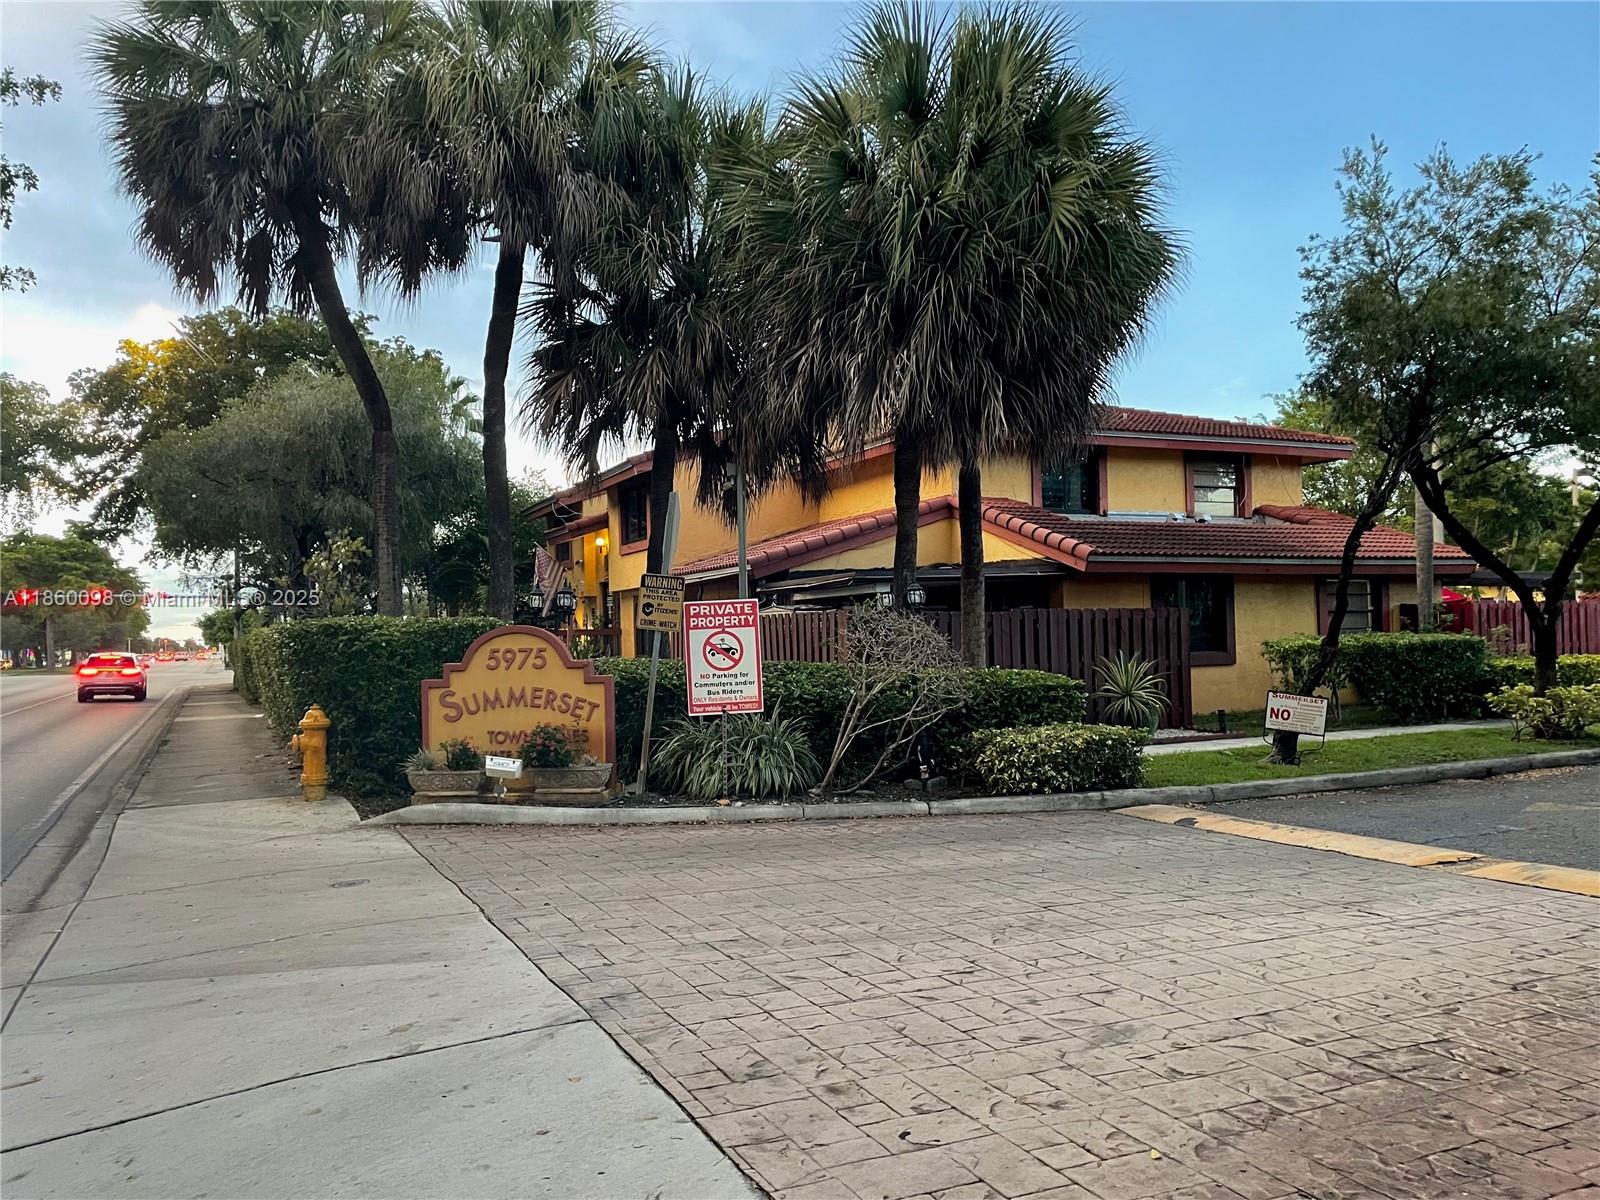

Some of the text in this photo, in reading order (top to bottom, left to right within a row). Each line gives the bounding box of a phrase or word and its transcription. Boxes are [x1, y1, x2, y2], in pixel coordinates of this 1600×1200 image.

[645, 576, 683, 590] WARNING
[643, 594, 680, 603] PROTECTED
[690, 603, 753, 616] PRIVATE
[640, 619, 677, 629] CRIME WATCH
[690, 615, 754, 628] PROPERTY
[486, 647, 547, 671] 5975
[1269, 707, 1291, 721] NO
